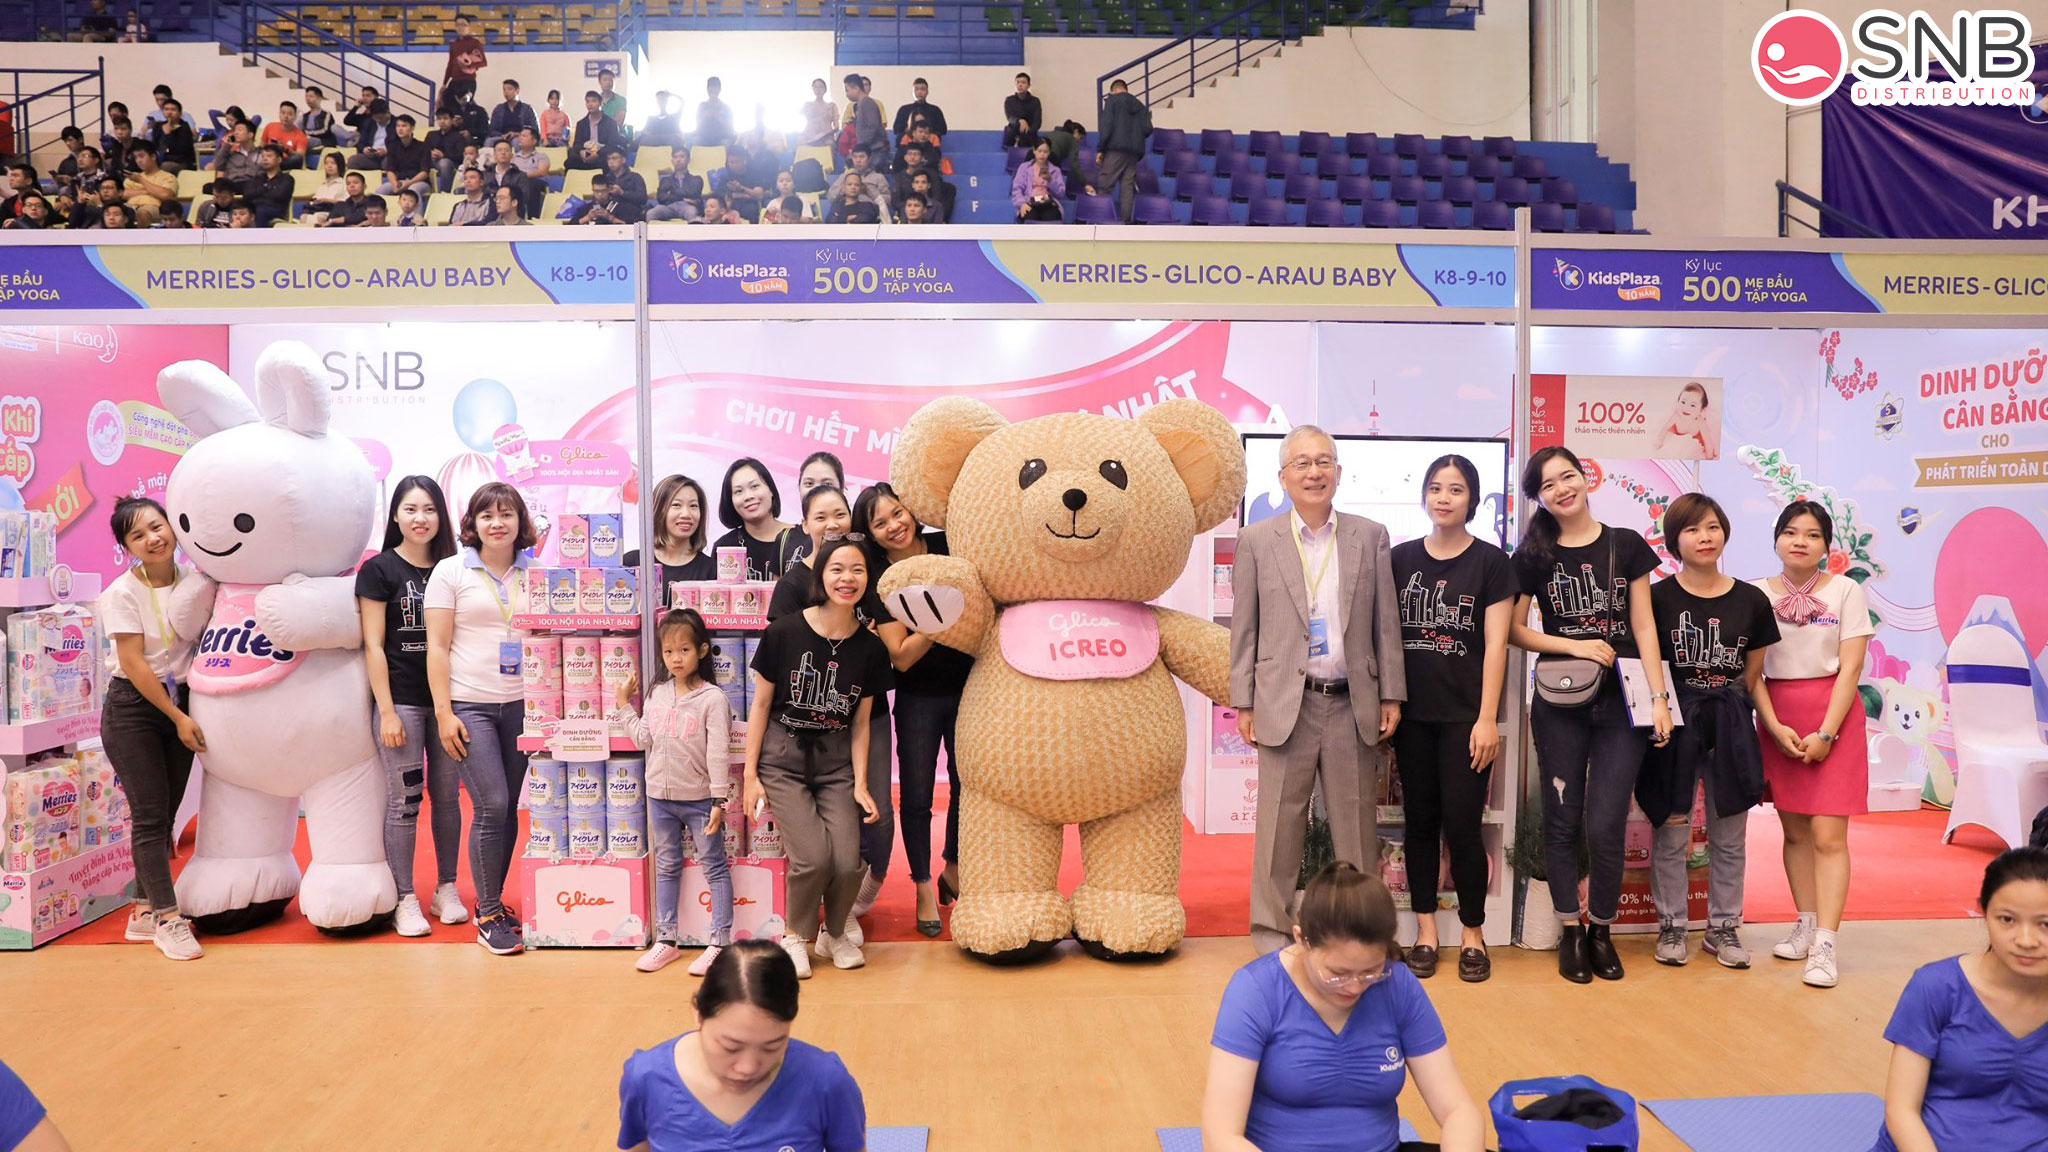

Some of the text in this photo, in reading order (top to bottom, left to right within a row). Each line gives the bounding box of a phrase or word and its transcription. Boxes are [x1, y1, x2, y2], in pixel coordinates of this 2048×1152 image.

[972, 200, 979, 212] F
[815, 248, 856, 264] Kỷ lục
[708, 264, 787, 279] KidsPlaza
[883, 262, 937, 281] MẸ BẦU
[1685, 258, 1722, 272] Kỷ lục
[12, 269, 42, 285] BẦU
[444, 266, 511, 287] BABY
[550, 265, 628, 282] K8-9-10
[813, 267, 878, 294] 500
[1333, 267, 1397, 287] BABY
[1434, 270, 1507, 287] K8-9-10
[1588, 270, 1660, 286] KidsPlaza
[1745, 272, 1793, 291] MẸ BẦU
[19, 288, 60, 301] YOGA
[749, 283, 762, 294] 10
[883, 279, 954, 296] TẬP YOGA
[1625, 290, 1637, 300] 10
[1682, 276, 1741, 302] 500
[1745, 290, 1807, 304] TẬP YOGA
[322, 351, 425, 392] SNB
[1920, 367, 1976, 398] DINH
[331, 395, 426, 405] ISTRIBUTION
[1577, 402, 1646, 425] 100%
[1886, 405, 1891, 416] 5
[1944, 400, 1984, 430] CÂN
[4, 407, 33, 432] Khí
[726, 398, 796, 434] CHƠI
[803, 410, 859, 448] HẾT
[1530, 424, 1556, 433] rau
[1981, 434, 2010, 449] CHO
[560, 446, 608, 466] Glico
[1926, 460, 1958, 480] PHÁT
[1960, 456, 1997, 479] TRIỂN
[2000, 458, 2039, 477] TOÀN
[48, 485, 80, 524] ỚI
[538, 616, 634, 627] 100% NỘI ĐỊA NHẬT BẢN
[706, 616, 721, 626] NỘI
[724, 617, 738, 626] ĐỊA
[740, 616, 762, 626] NHẬT
[1048, 611, 1121, 638] Glico
[1810, 616, 1839, 625] Merries
[1050, 638, 1127, 661] ICREO
[205, 658, 232, 668] メリーズ
[566, 661, 594, 669] アイクレオ
[604, 661, 632, 669] アイクレオ
[648, 706, 700, 743] GAP
[570, 782, 598, 790] アイクレオ
[609, 782, 637, 790] アイクレオ
[42, 792, 78, 812] Merries
[572, 835, 600, 843] アイクレオ
[610, 835, 639, 843] アイクレオ
[556, 890, 615, 914] Glico
